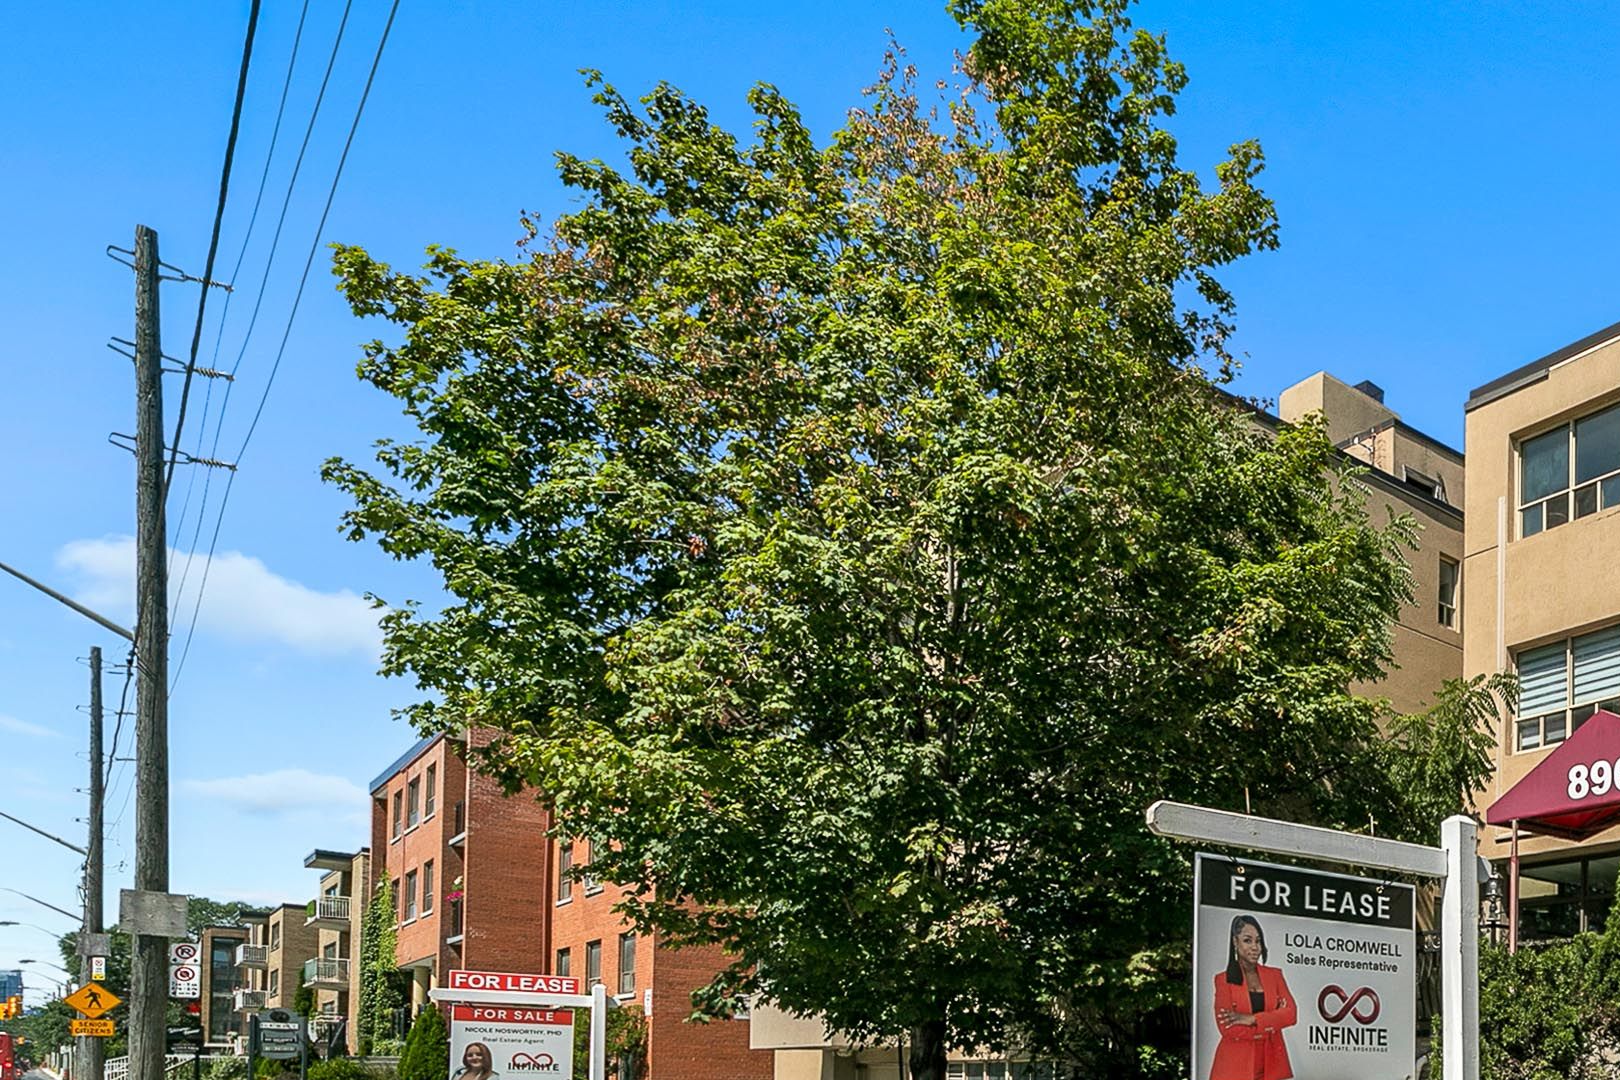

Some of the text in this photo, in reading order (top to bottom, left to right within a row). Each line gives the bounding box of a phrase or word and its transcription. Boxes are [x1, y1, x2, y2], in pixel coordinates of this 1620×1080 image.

[1230, 875, 1391, 919] FOR LEASE
[1284, 933, 1403, 957] LOLA CROMWELL
[1286, 952, 1398, 974] Sales Representative
[455, 973, 575, 993] FOR LEASE
[474, 1008, 554, 1021] FOR SALE
[78, 1021, 109, 1029] SENIOR
[465, 1026, 493, 1035] NICOLE
[1309, 1025, 1388, 1046] INFINITE
[508, 1062, 560, 1071] INFINITE
